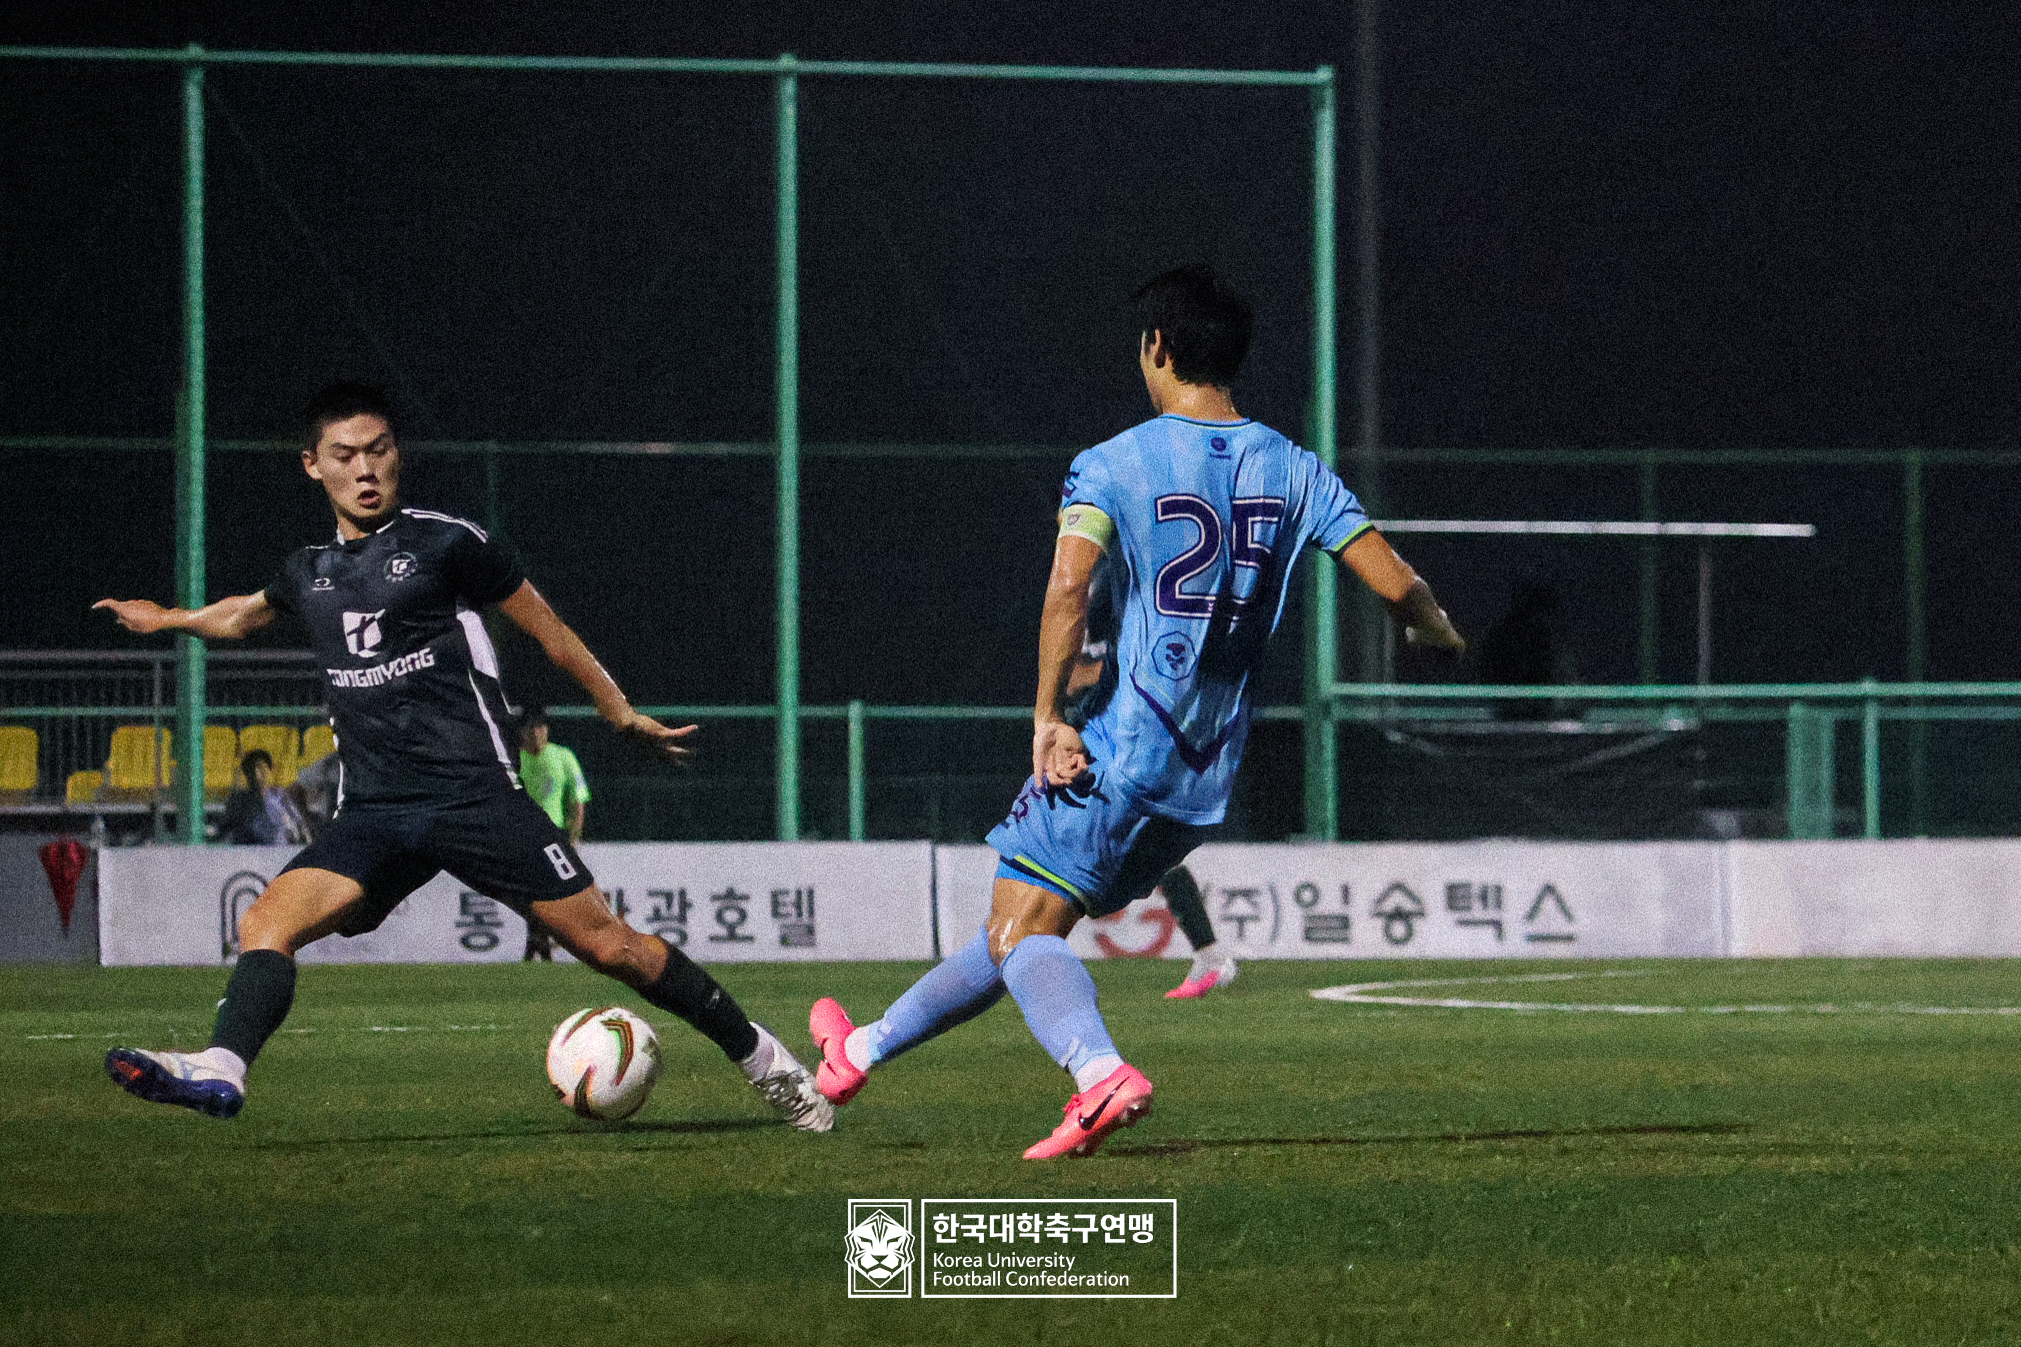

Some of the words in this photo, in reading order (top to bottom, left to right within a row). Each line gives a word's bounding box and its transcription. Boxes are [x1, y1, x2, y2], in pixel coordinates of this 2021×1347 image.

[1153, 493, 1286, 621] 25
[543, 843, 577, 880] 8
[455, 886, 817, 951] 통광호텔
